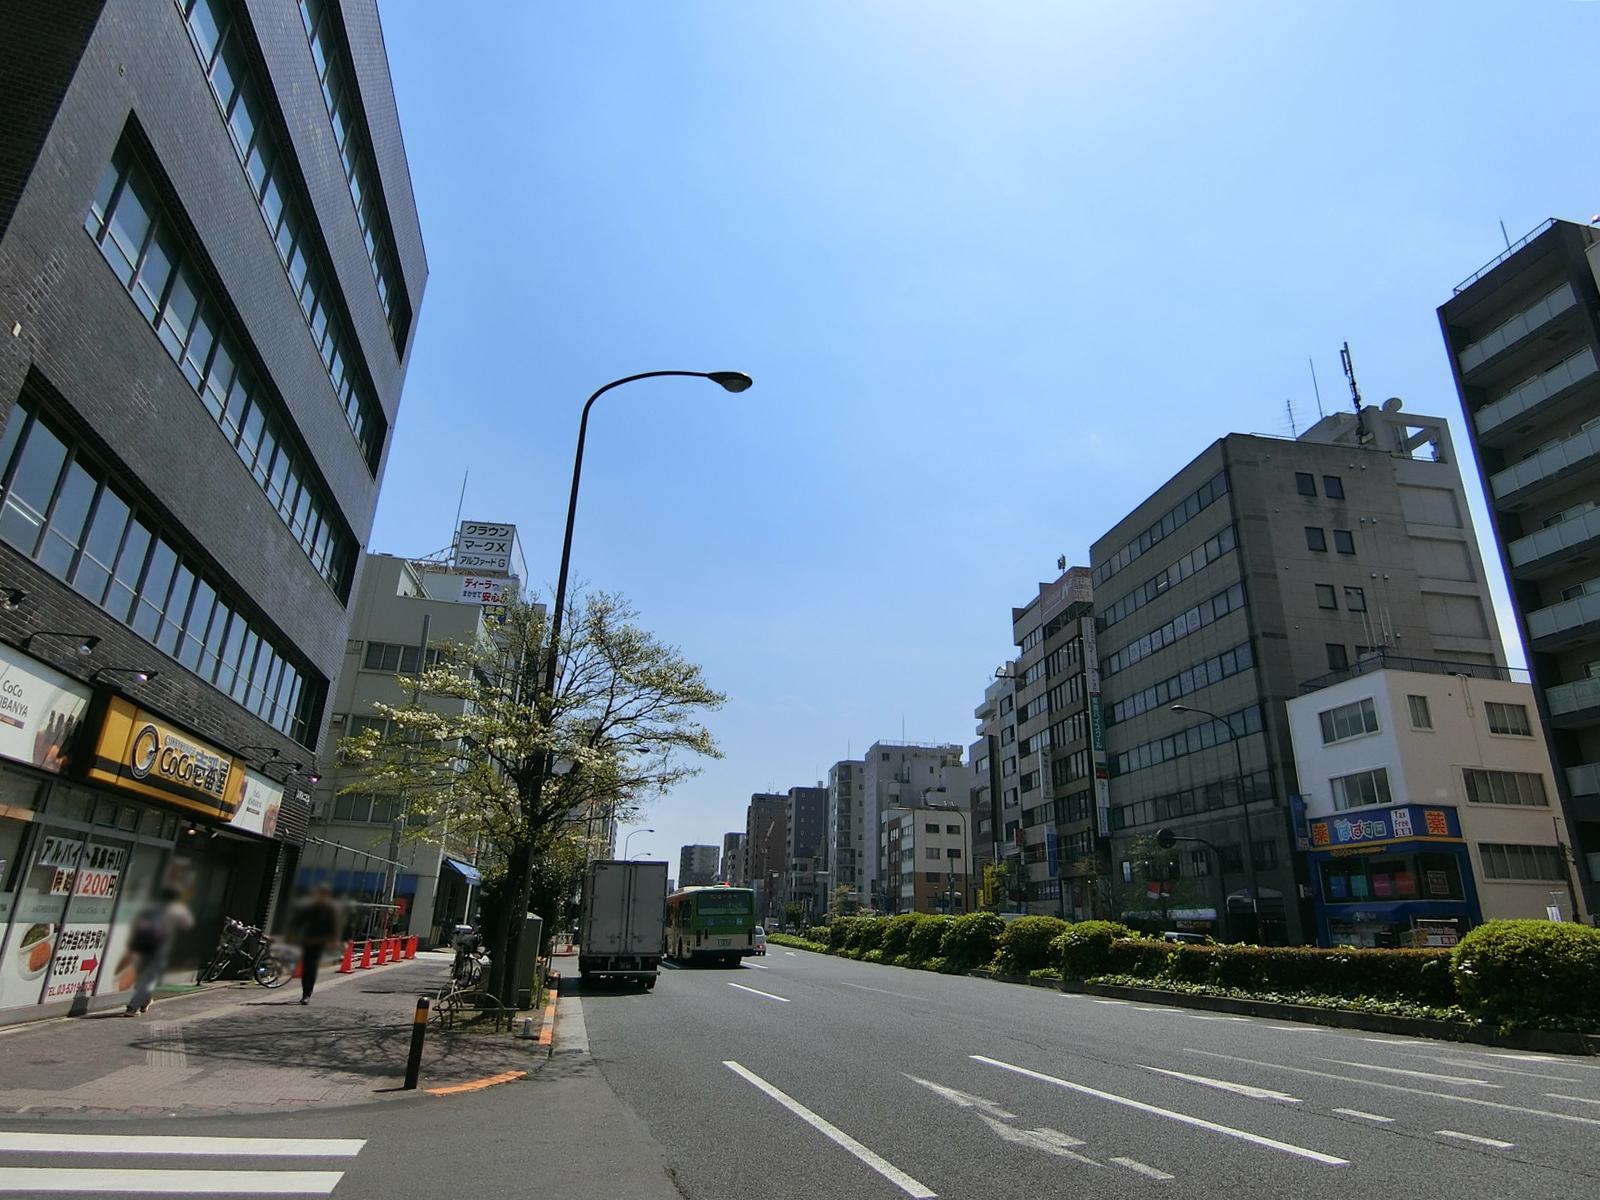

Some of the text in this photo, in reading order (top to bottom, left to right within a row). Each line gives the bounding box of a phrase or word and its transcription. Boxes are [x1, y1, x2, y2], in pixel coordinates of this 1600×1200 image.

[466, 525, 509, 537] クラウン
[464, 540, 507, 553] マークX
[2, 680, 23, 698] CoCo
[1394, 810, 1406, 819] Tax
[1395, 820, 1409, 828] Free
[1426, 811, 1446, 834] 薬
[1313, 823, 1329, 844] 薬
[41, 839, 124, 870] アルバイ募集中!!
